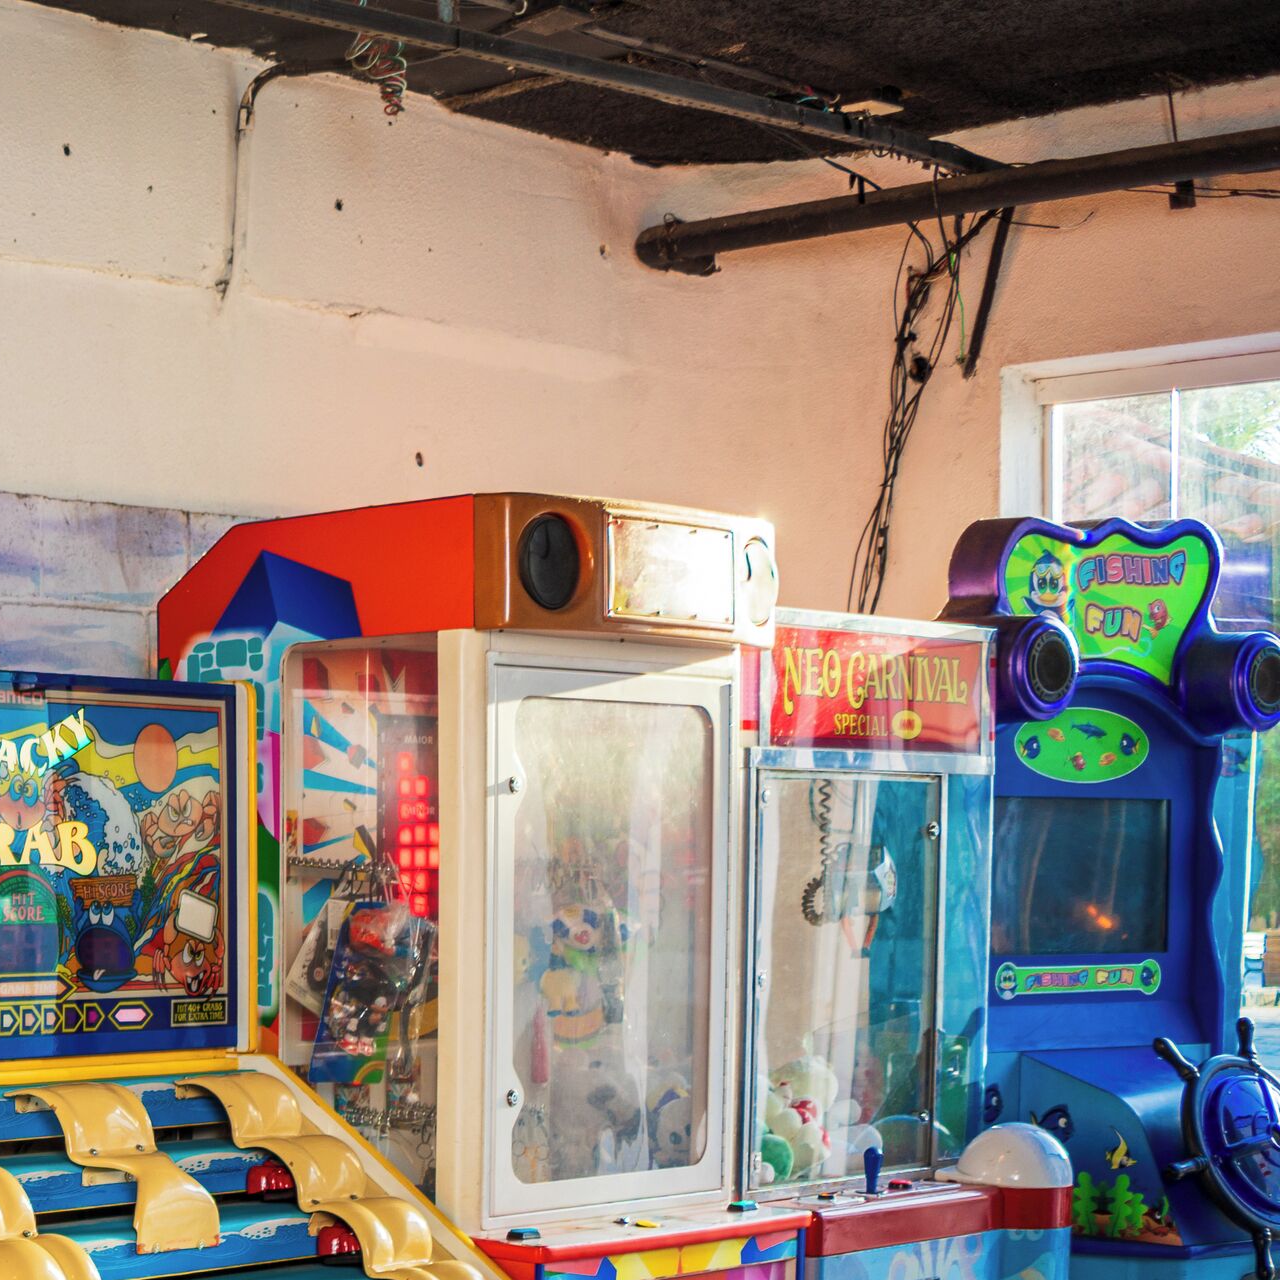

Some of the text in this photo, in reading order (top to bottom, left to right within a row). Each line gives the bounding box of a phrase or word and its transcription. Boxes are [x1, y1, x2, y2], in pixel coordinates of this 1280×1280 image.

[1078, 550, 1186, 591] FISHING
[1085, 603, 1143, 643] FUN
[782, 646, 969, 716] NEO CARNIVAL
[833, 713, 889, 737] SPECIAL
[403, 735, 434, 745] MAIOR
[11, 891, 37, 907] HIT
[83, 881, 133, 898] HI SCORE
[2, 904, 46, 923] SCORE
[1025, 967, 1135, 992] FISHING FUN
[202, 1002, 224, 1012] CRABS
